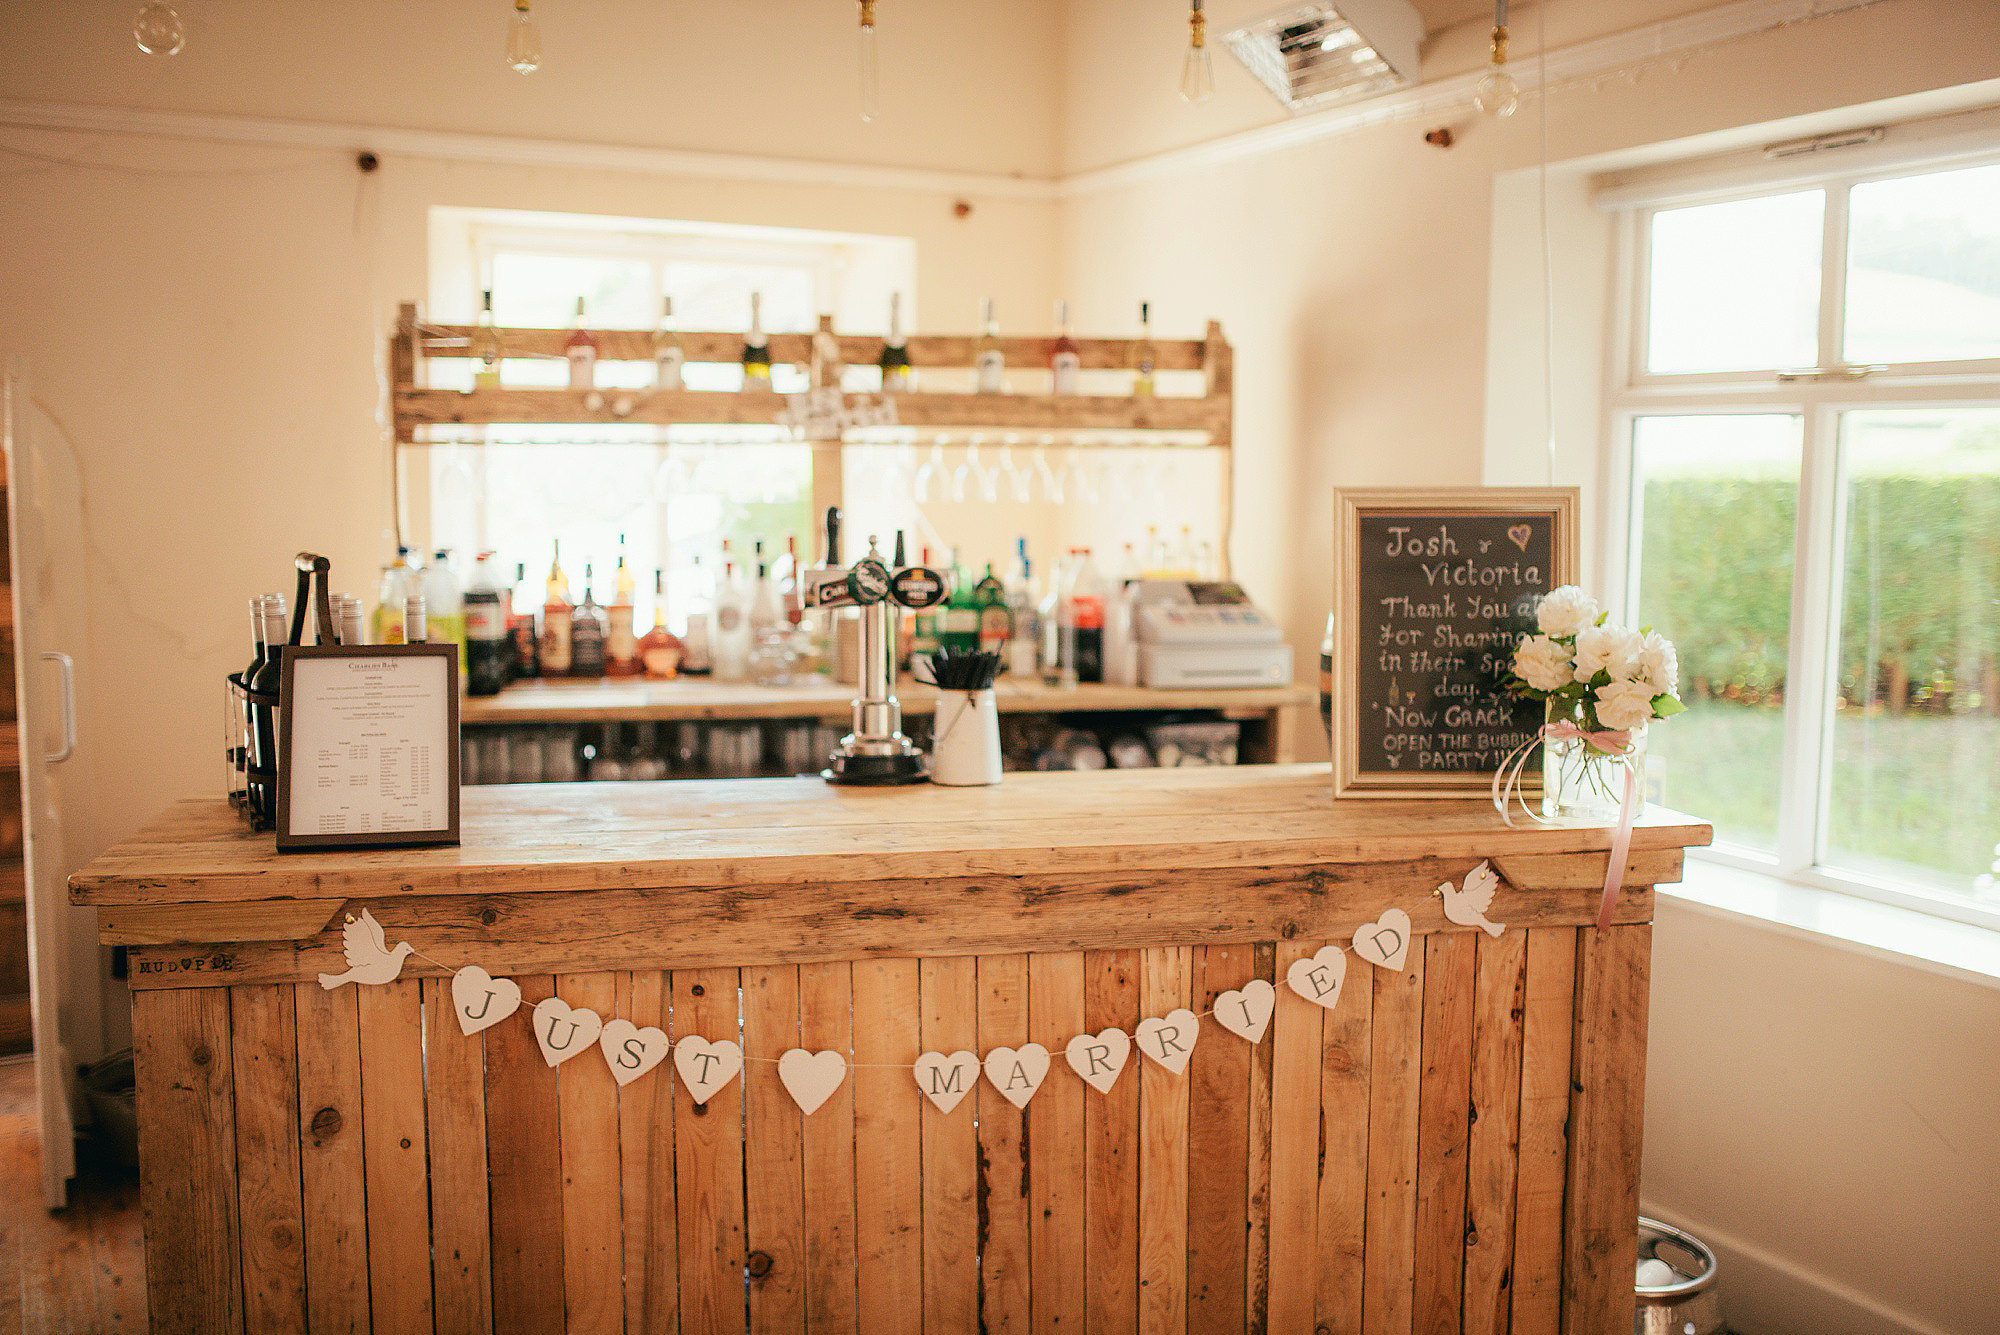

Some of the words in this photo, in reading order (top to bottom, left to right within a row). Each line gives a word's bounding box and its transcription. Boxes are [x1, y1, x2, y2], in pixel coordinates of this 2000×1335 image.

[1386, 525, 1459, 557] Josh
[1422, 559, 1542, 587] Victoria
[1380, 594, 1457, 619] Thank
[1467, 595, 1510, 619] You
[1383, 734, 1432, 751] OPEN
[1438, 733, 1472, 749] THE
[464, 989, 721, 1085] JUST
[929, 926, 1403, 1095] MARRIED
